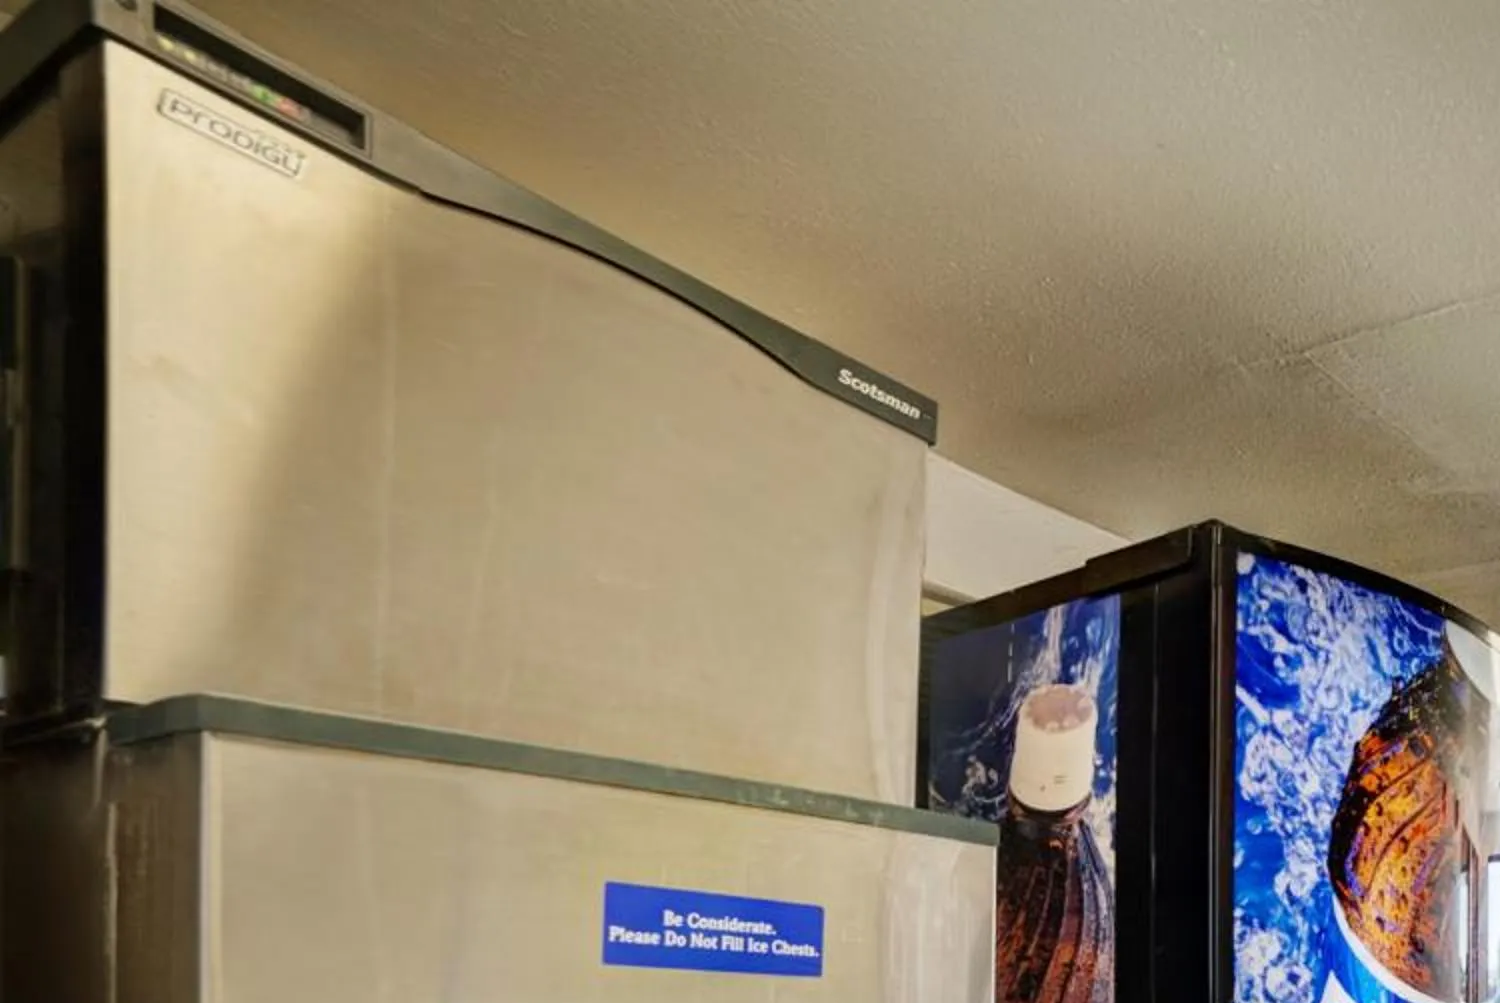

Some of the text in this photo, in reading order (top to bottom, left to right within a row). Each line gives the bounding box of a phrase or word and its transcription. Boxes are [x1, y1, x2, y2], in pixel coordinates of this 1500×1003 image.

[838, 368, 921, 419] Scotsman
[663, 909, 776, 935] Be Considerate.
[609, 926, 819, 957] Please Do Not Fill Ice Chests.
